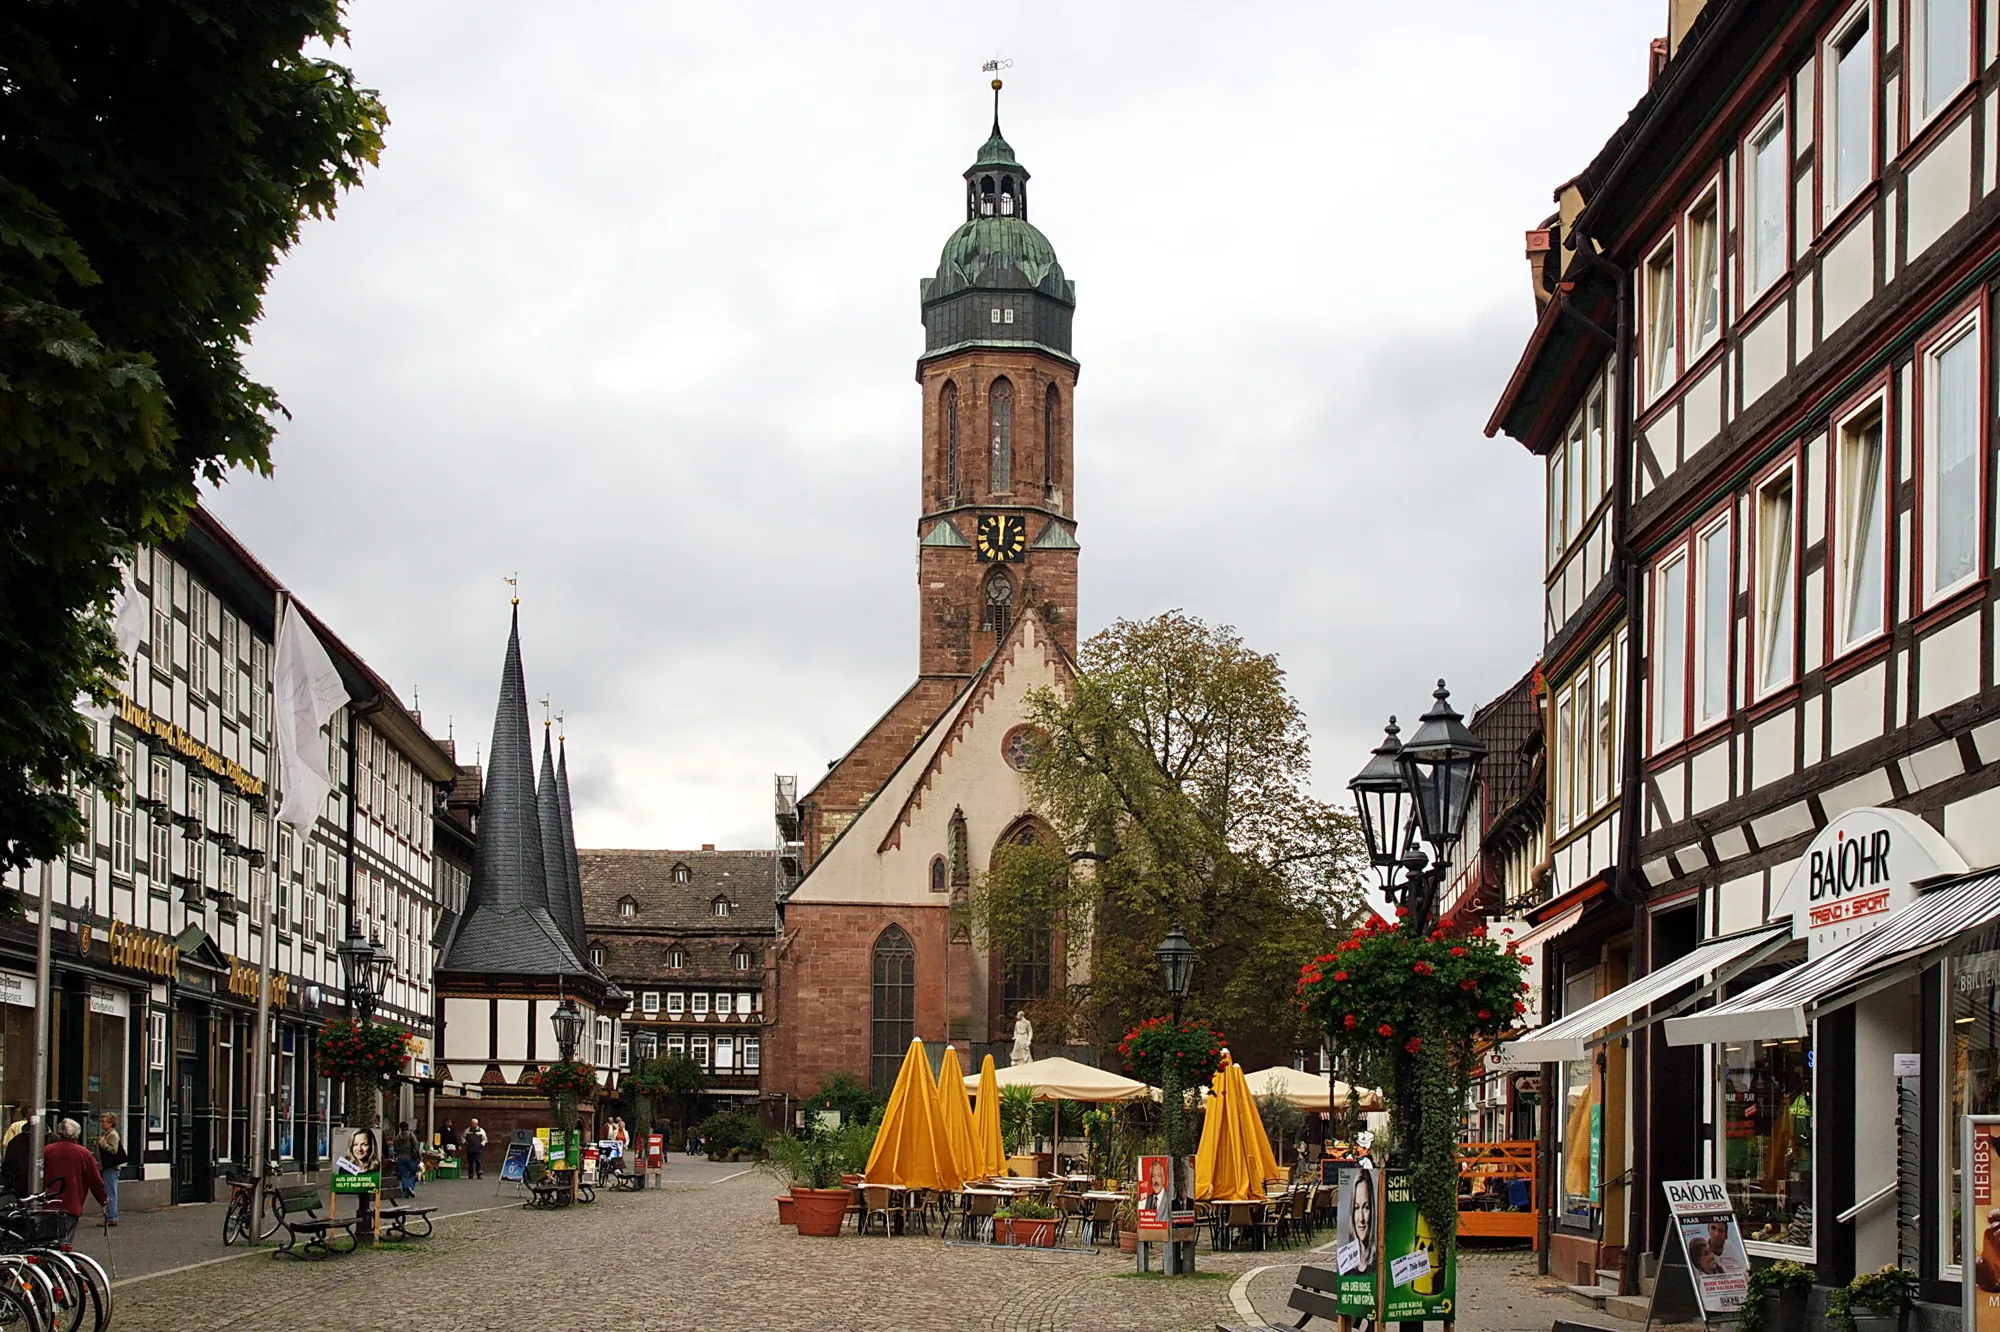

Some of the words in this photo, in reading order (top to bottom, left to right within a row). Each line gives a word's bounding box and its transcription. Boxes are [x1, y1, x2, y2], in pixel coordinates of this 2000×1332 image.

[1809, 905, 1842, 926] TREND
[1852, 893, 1889, 914] SPORT
[1960, 970, 1998, 992] BRILLEN
[1974, 1130, 1990, 1199] HERBST
[1388, 1189, 1410, 1203] NEIN
